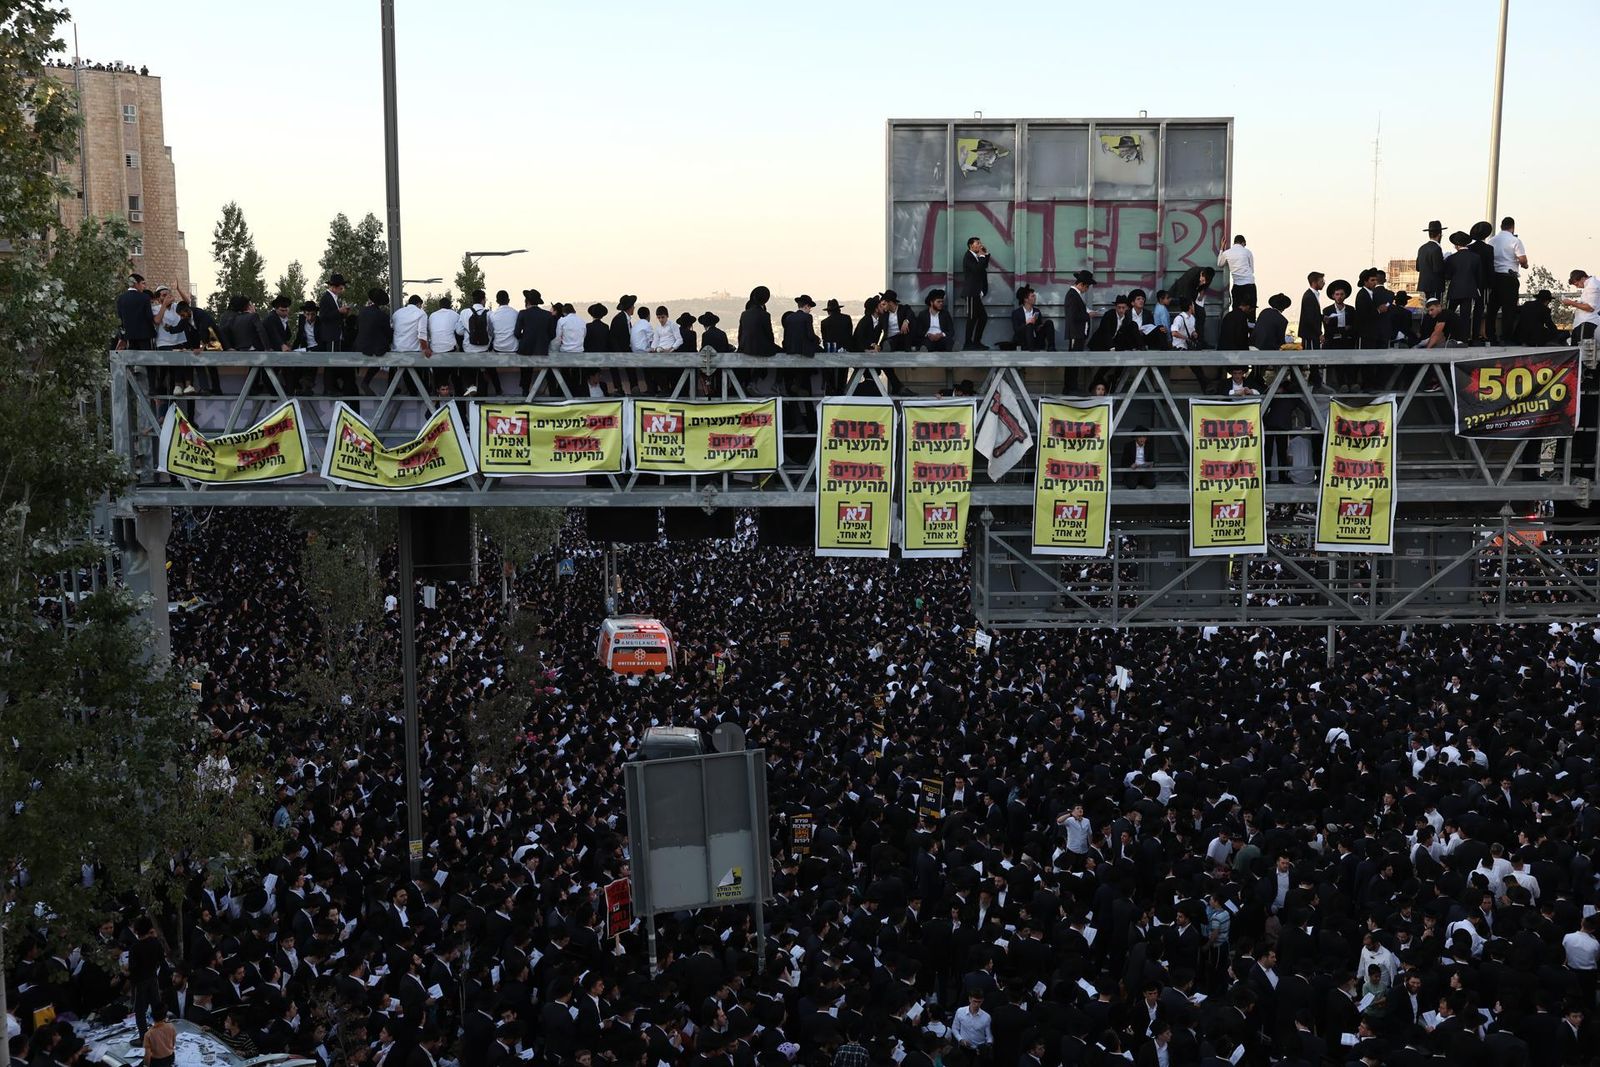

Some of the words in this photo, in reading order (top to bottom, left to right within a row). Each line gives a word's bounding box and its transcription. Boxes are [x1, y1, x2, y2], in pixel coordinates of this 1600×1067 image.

[1478, 367, 1568, 402] 50%
[534, 416, 587, 430] למעצרים.
[688, 414, 741, 427] למעצרים.
[494, 436, 524, 446] אפילו
[648, 434, 678, 444] אפילו
[1196, 436, 1257, 452] למעצרים.
[1330, 434, 1388, 450] למעצרים.
[824, 438, 889, 453] למעצרים.
[909, 438, 970, 454] למעצרים.
[1042, 437, 1105, 452] למעצרים.
[486, 449, 512, 459] אחד.
[516, 448, 530, 458] לא
[641, 446, 666, 456] אחד.
[670, 446, 684, 456] לא
[704, 449, 758, 462] מהיעדים.
[550, 451, 604, 463] מהיעדים.
[823, 479, 888, 494] מהיעדים.
[908, 480, 972, 495] מהיעדים.
[1040, 478, 1104, 493] מהיעדים.
[1196, 476, 1259, 493] מהיעדים.
[1326, 475, 1389, 492] מהיעדים.
[842, 522, 867, 530] אפילו
[929, 522, 953, 531] אפילו
[1058, 520, 1082, 528] אפילו
[1216, 519, 1240, 528] אפילו
[1342, 517, 1366, 526] אפילו
[837, 531, 857, 539] אחד.
[860, 529, 871, 539] לא
[923, 531, 944, 539] אחד.
[946, 530, 958, 539] לא
[1052, 529, 1072, 537] אחד.
[1075, 528, 1086, 538] לא
[1211, 529, 1231, 537] אחד.
[1234, 528, 1245, 537] לא
[1336, 526, 1357, 535] אחד.
[1360, 525, 1371, 535] לא
